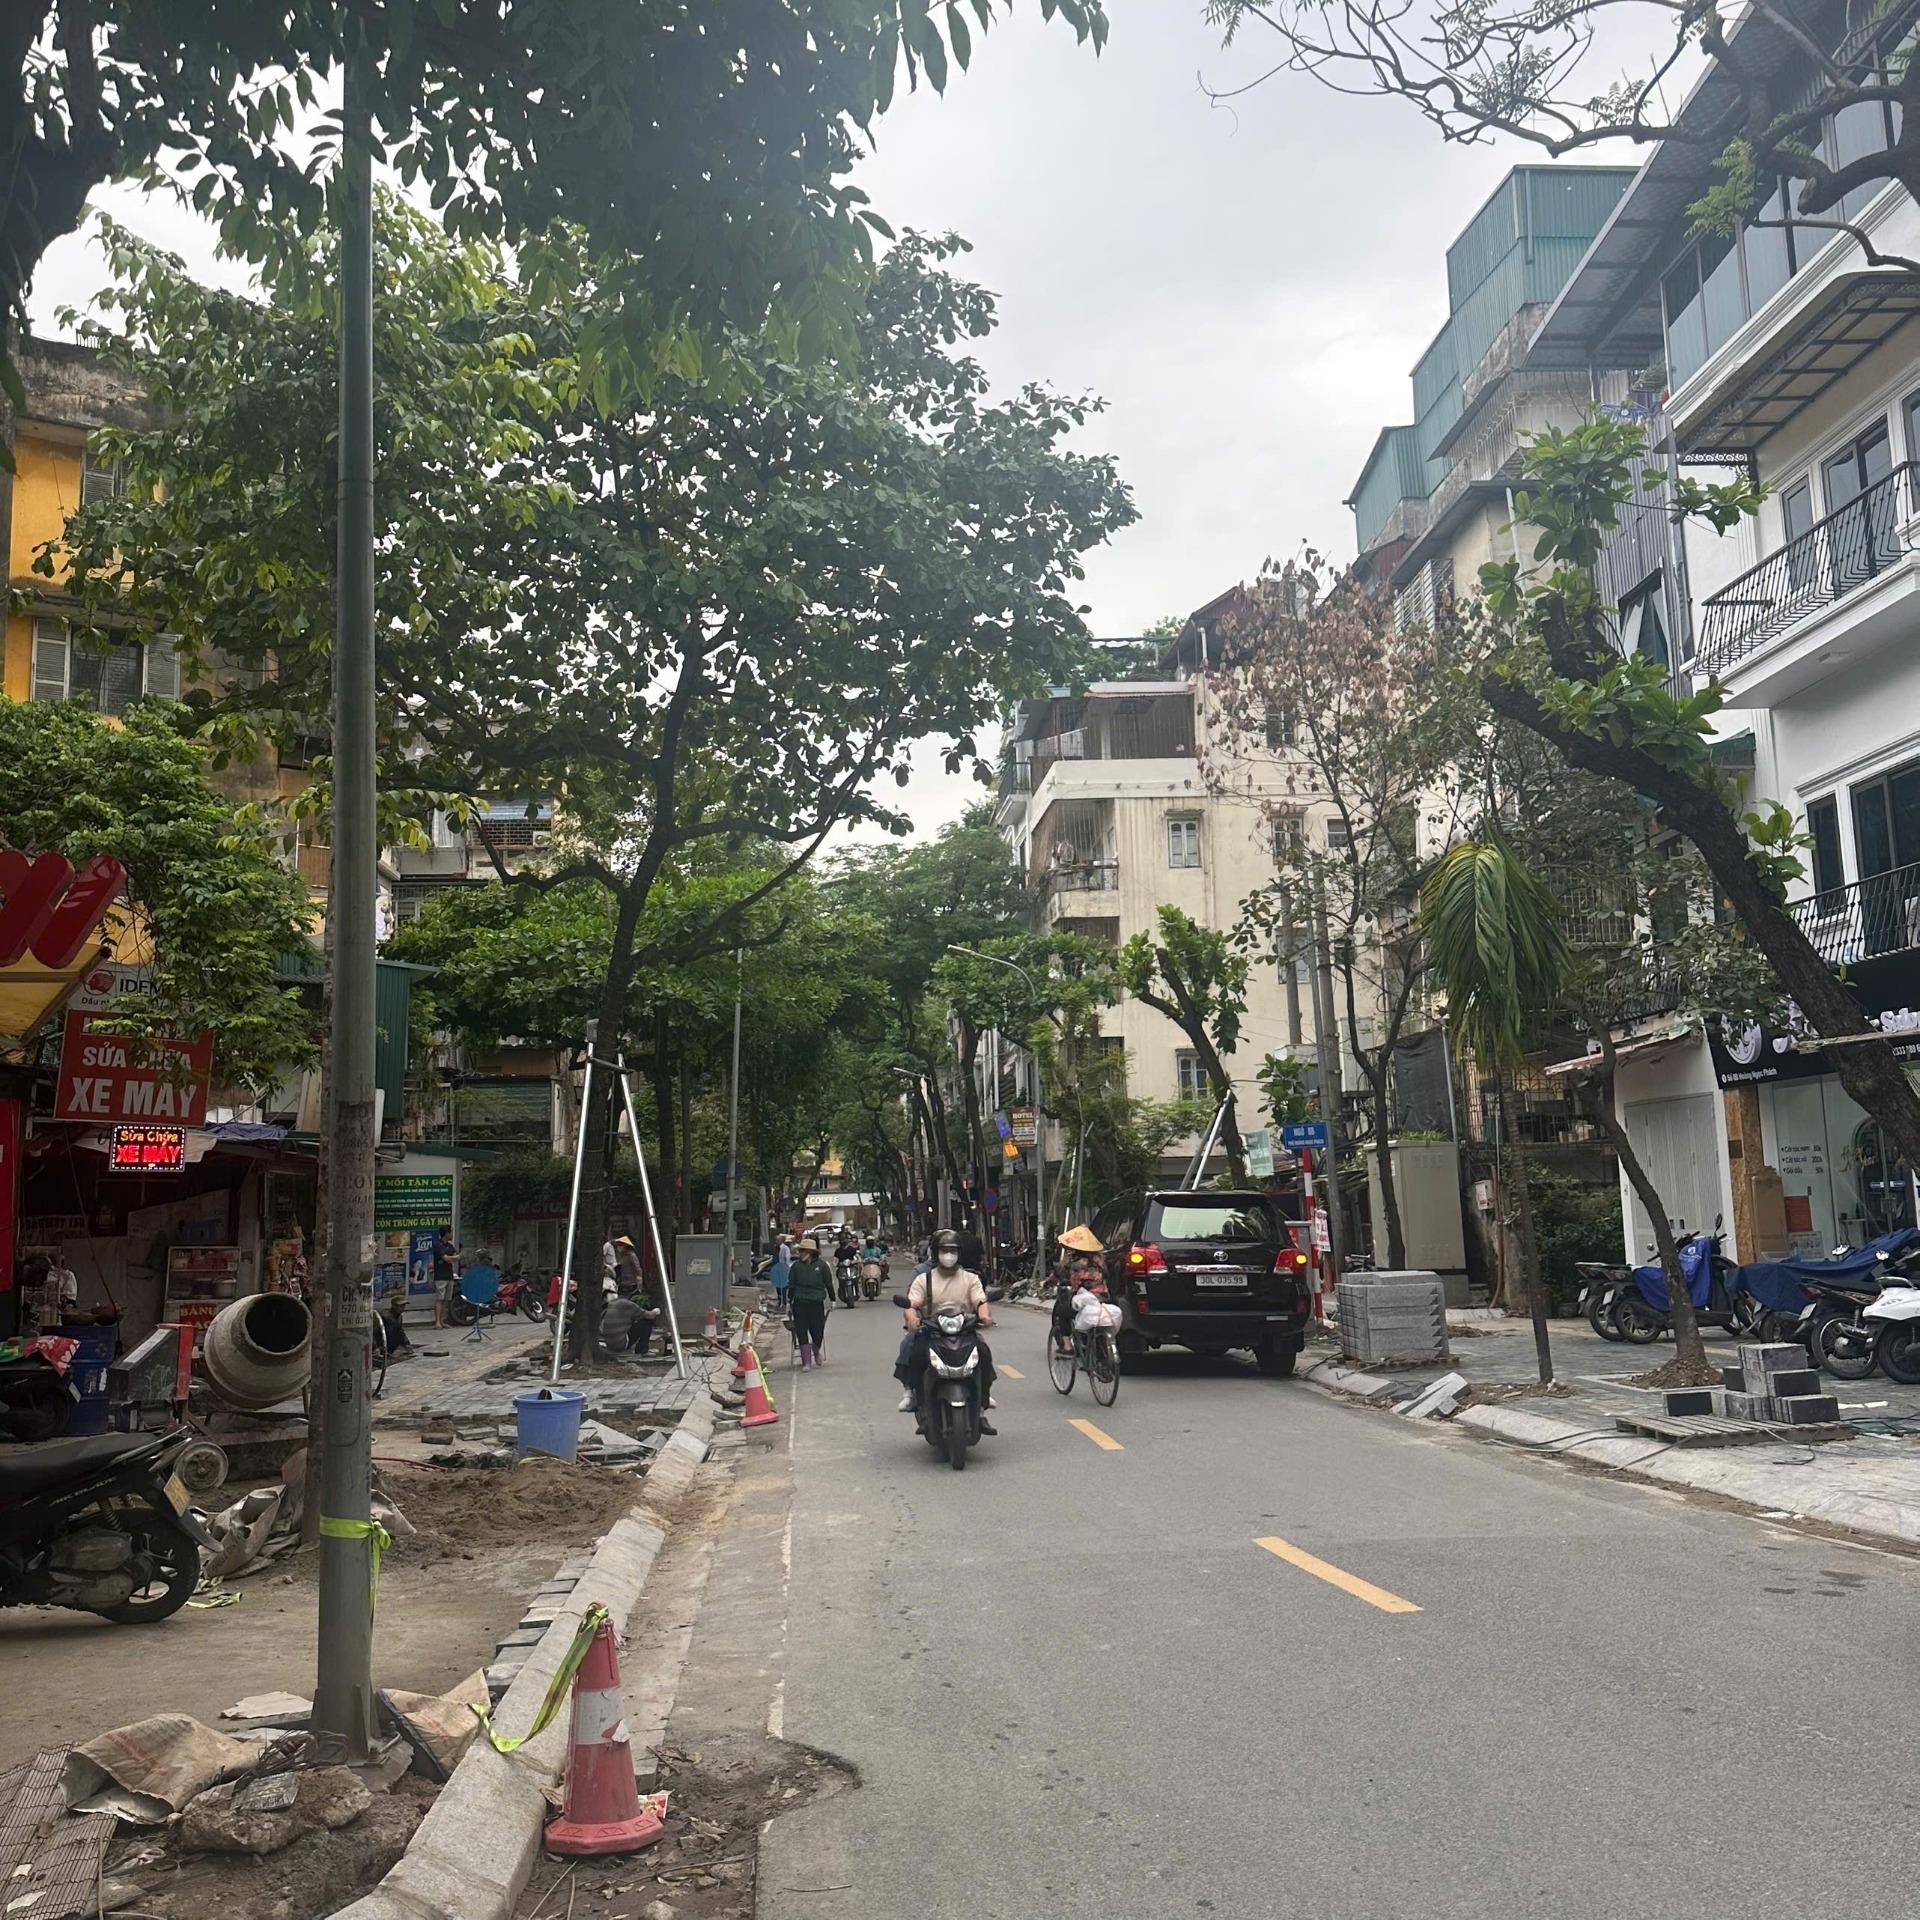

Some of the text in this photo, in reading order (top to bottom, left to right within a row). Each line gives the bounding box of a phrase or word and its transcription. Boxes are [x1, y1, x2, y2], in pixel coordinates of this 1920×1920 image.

[82, 1041, 127, 1068] SỬA
[67, 1077, 113, 1114] XE
[115, 1141, 180, 1163] XE MÁY
